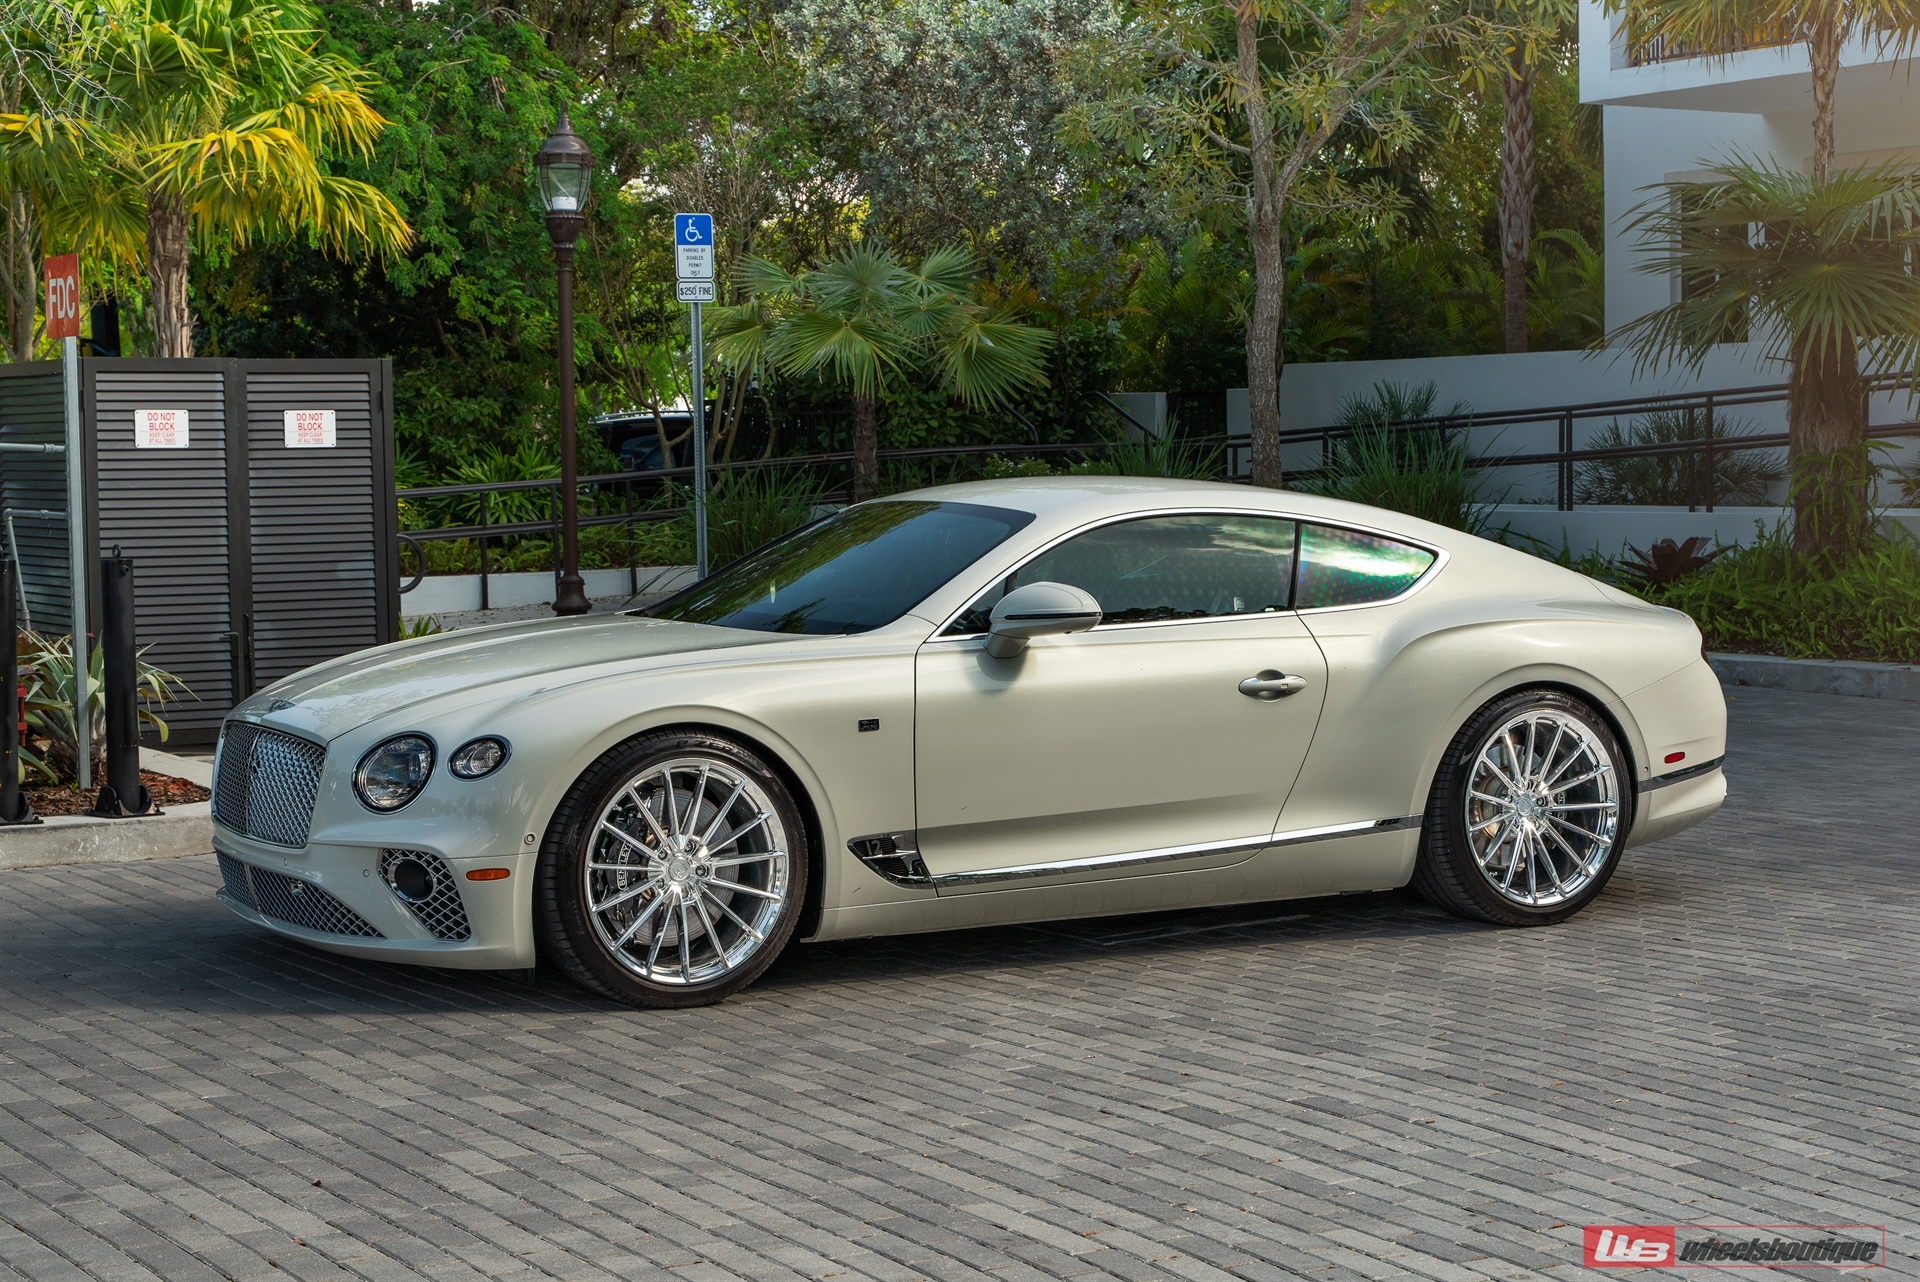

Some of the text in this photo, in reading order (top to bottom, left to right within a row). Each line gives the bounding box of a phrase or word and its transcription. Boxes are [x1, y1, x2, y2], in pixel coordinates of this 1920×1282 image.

[680, 286, 712, 296] $250 FINE
[49, 275, 75, 319] FDC
[148, 412, 176, 421] DO NOT
[297, 413, 323, 421] DO NOT
[149, 422, 175, 431] BLOCK
[298, 422, 323, 431] BLOCK
[865, 840, 883, 856] 12
[619, 844, 629, 886] BENLEY
